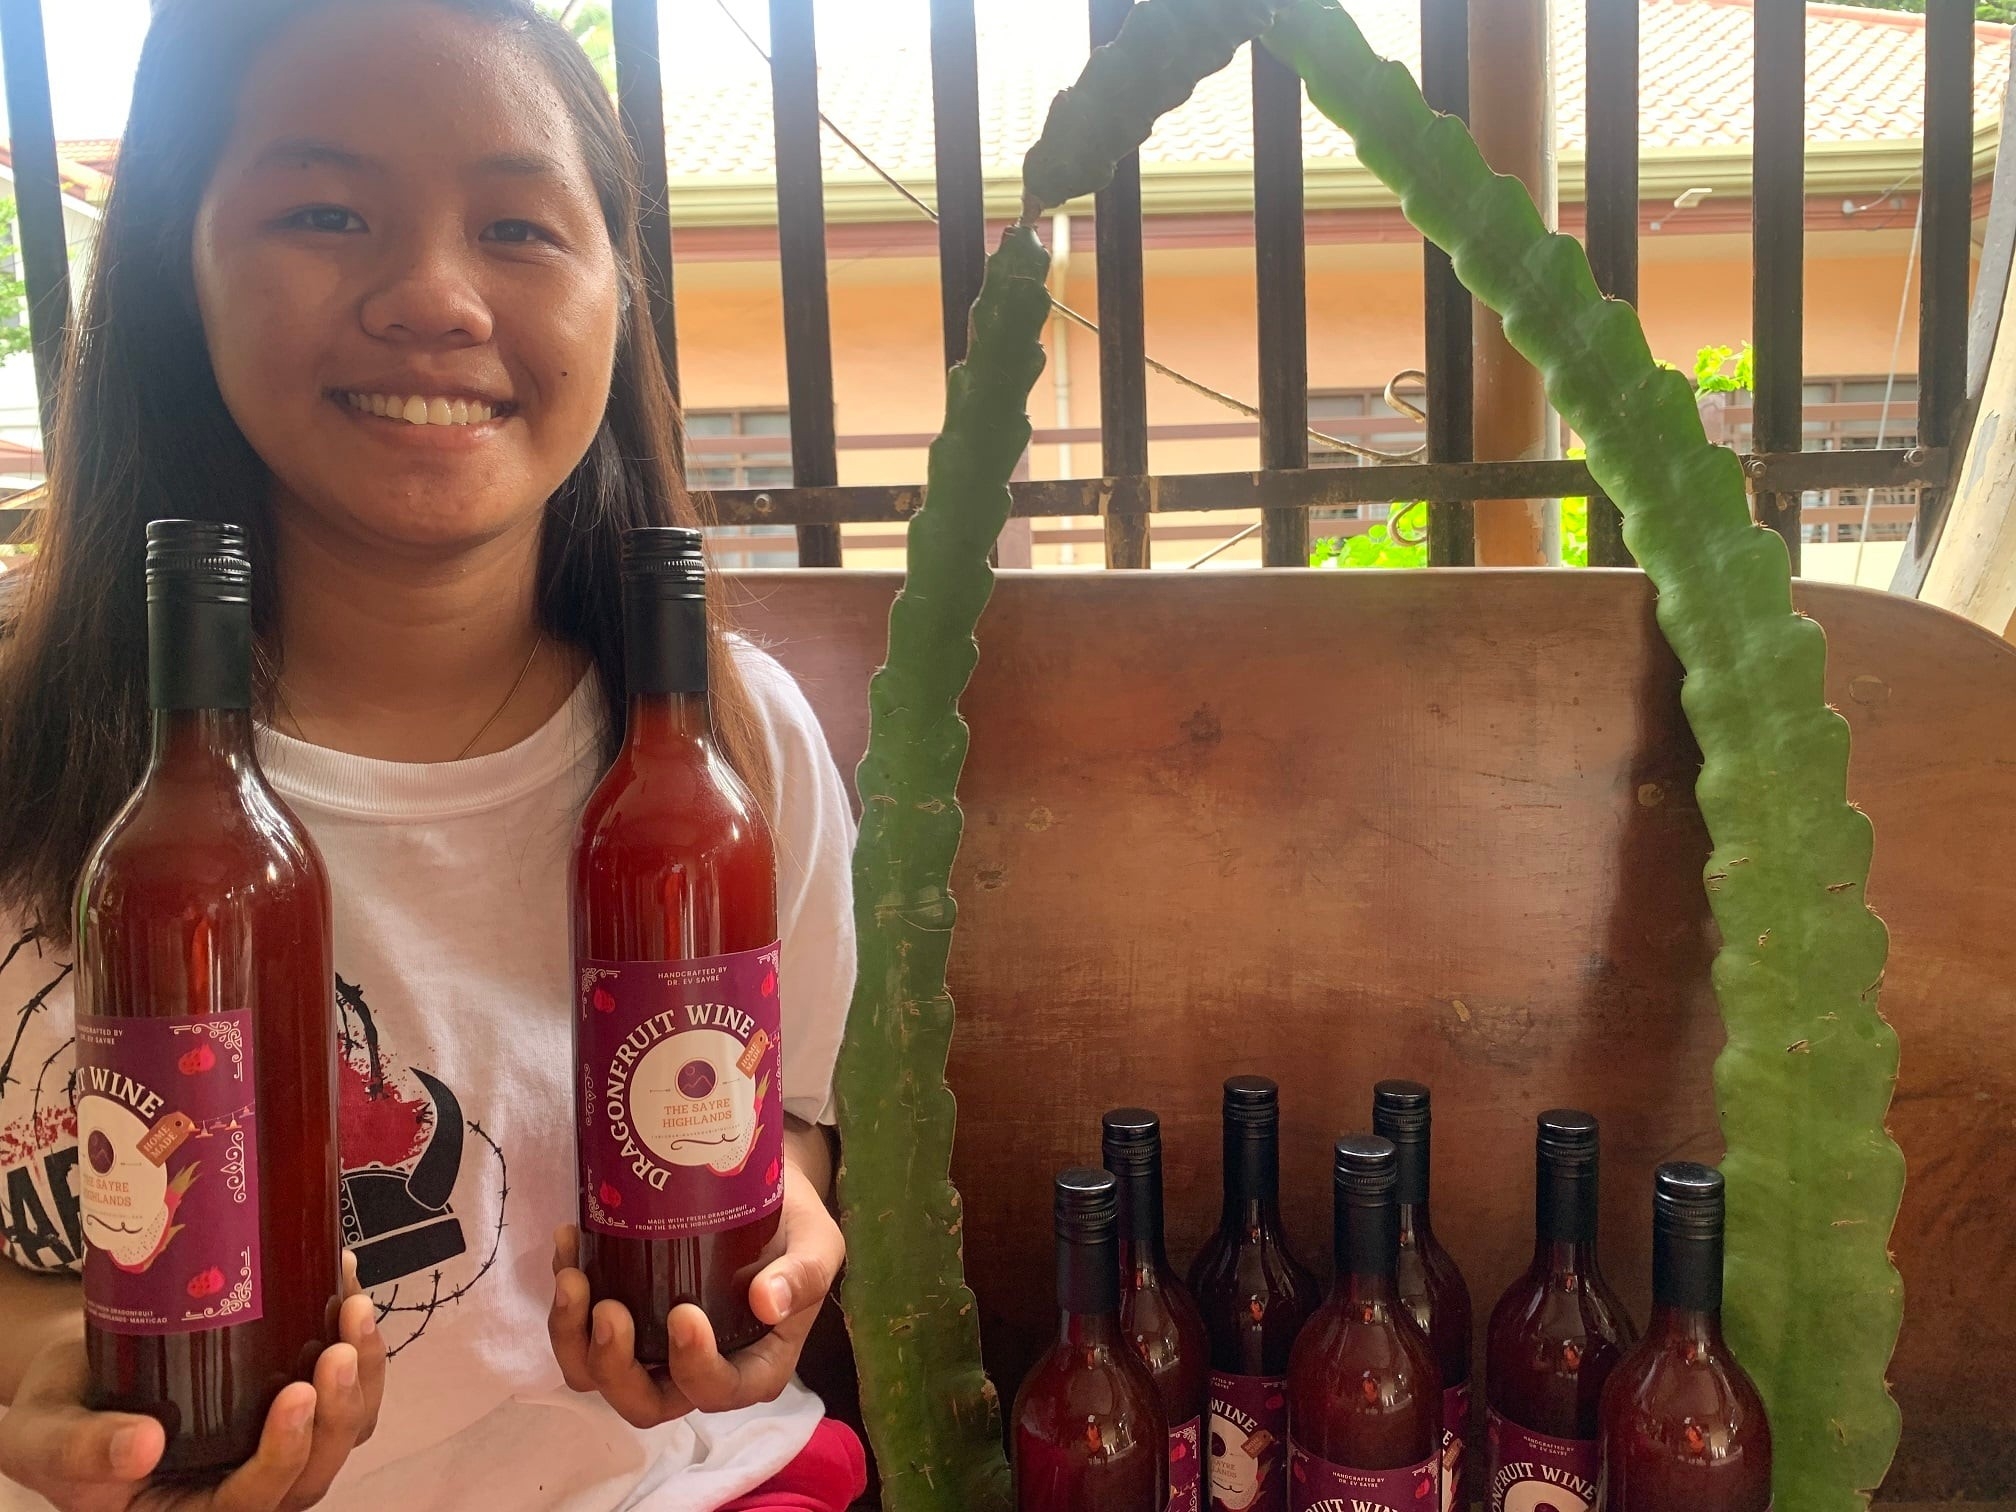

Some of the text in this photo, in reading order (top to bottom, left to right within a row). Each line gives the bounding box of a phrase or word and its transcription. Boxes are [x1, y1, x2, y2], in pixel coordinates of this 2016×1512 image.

[658, 968, 716, 979] HANDCRAFTED
[696, 974, 720, 984] SAYRE
[89, 1066, 165, 1119] WINE
[606, 1003, 755, 1191] DRAGONFRUIT WINE
[664, 1098, 731, 1115] THE SAYRE
[663, 1110, 732, 1128] HIGHLANDS
[143, 1124, 170, 1152] HOME
[151, 1131, 178, 1158] MADE
[96, 1178, 129, 1193] SAYRE
[708, 1204, 748, 1219] DRAGONFRUIT
[1211, 1397, 1258, 1433] WINE
[1332, 1471, 1375, 1482] HANDCRAFTED
[1541, 1464, 1596, 1500] WINE
